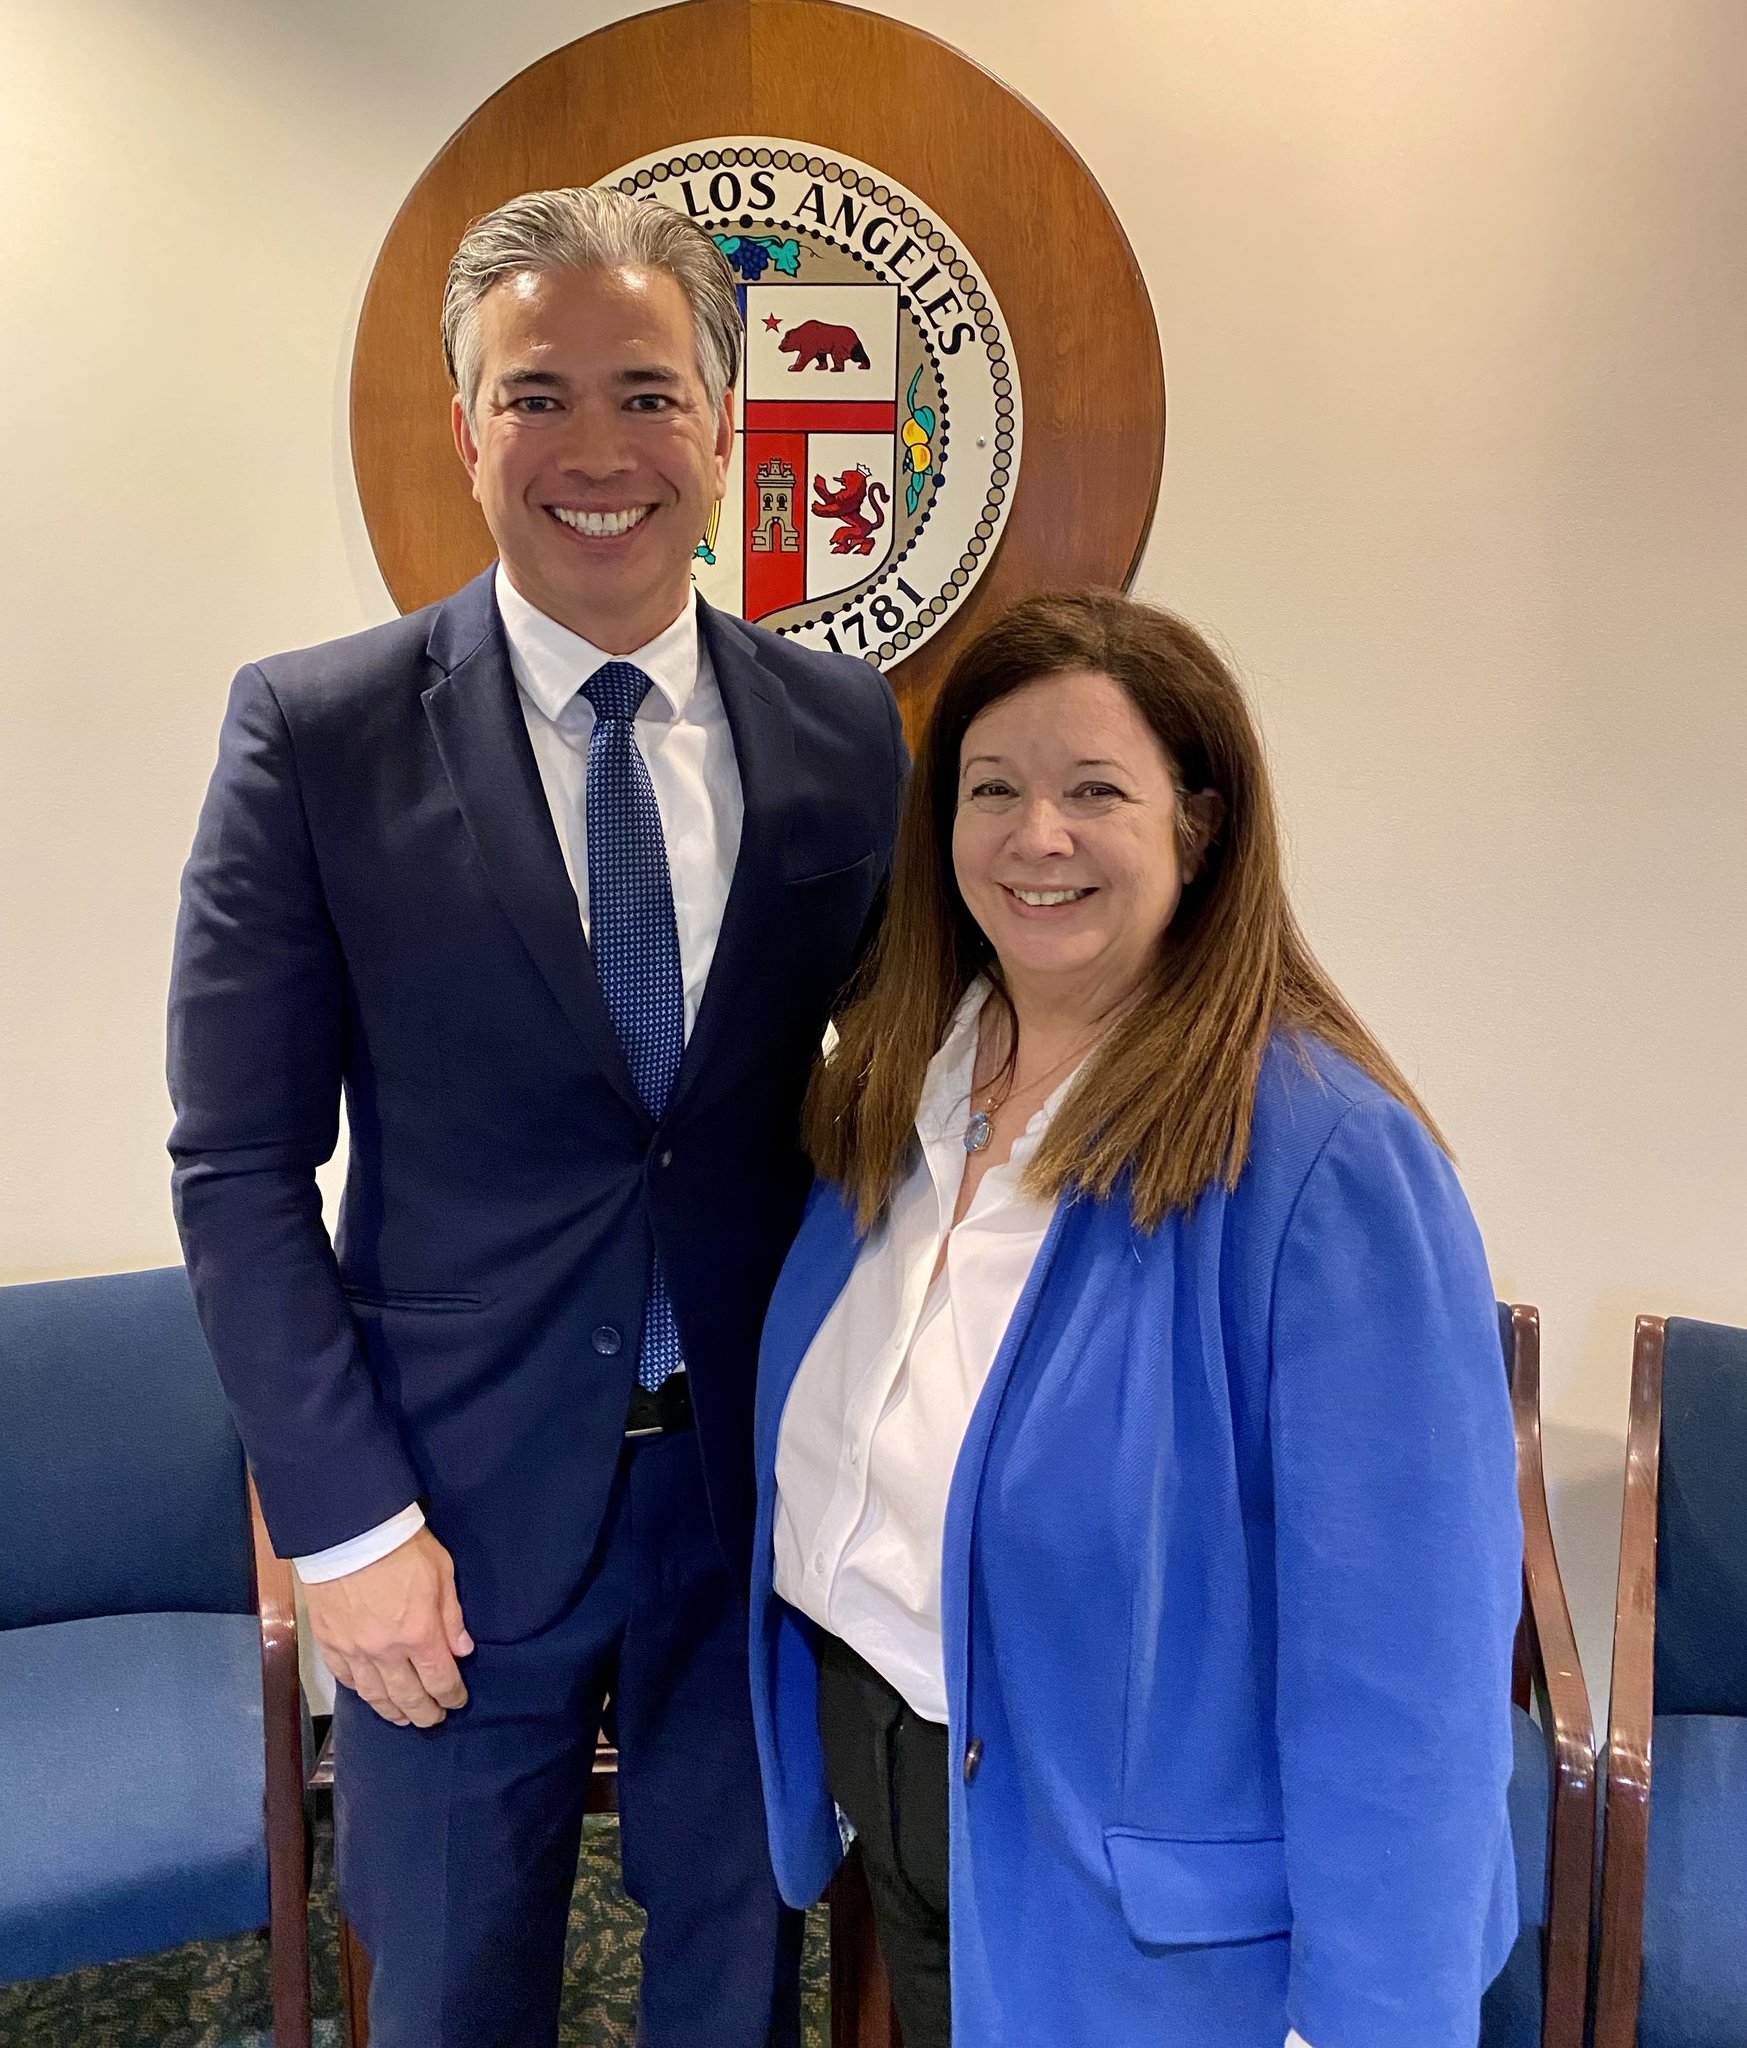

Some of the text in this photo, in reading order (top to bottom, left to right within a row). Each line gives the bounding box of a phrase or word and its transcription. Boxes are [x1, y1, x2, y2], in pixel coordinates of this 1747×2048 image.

[679, 171, 976, 355] LOS ANGELES
[823, 576, 926, 654] 1781
